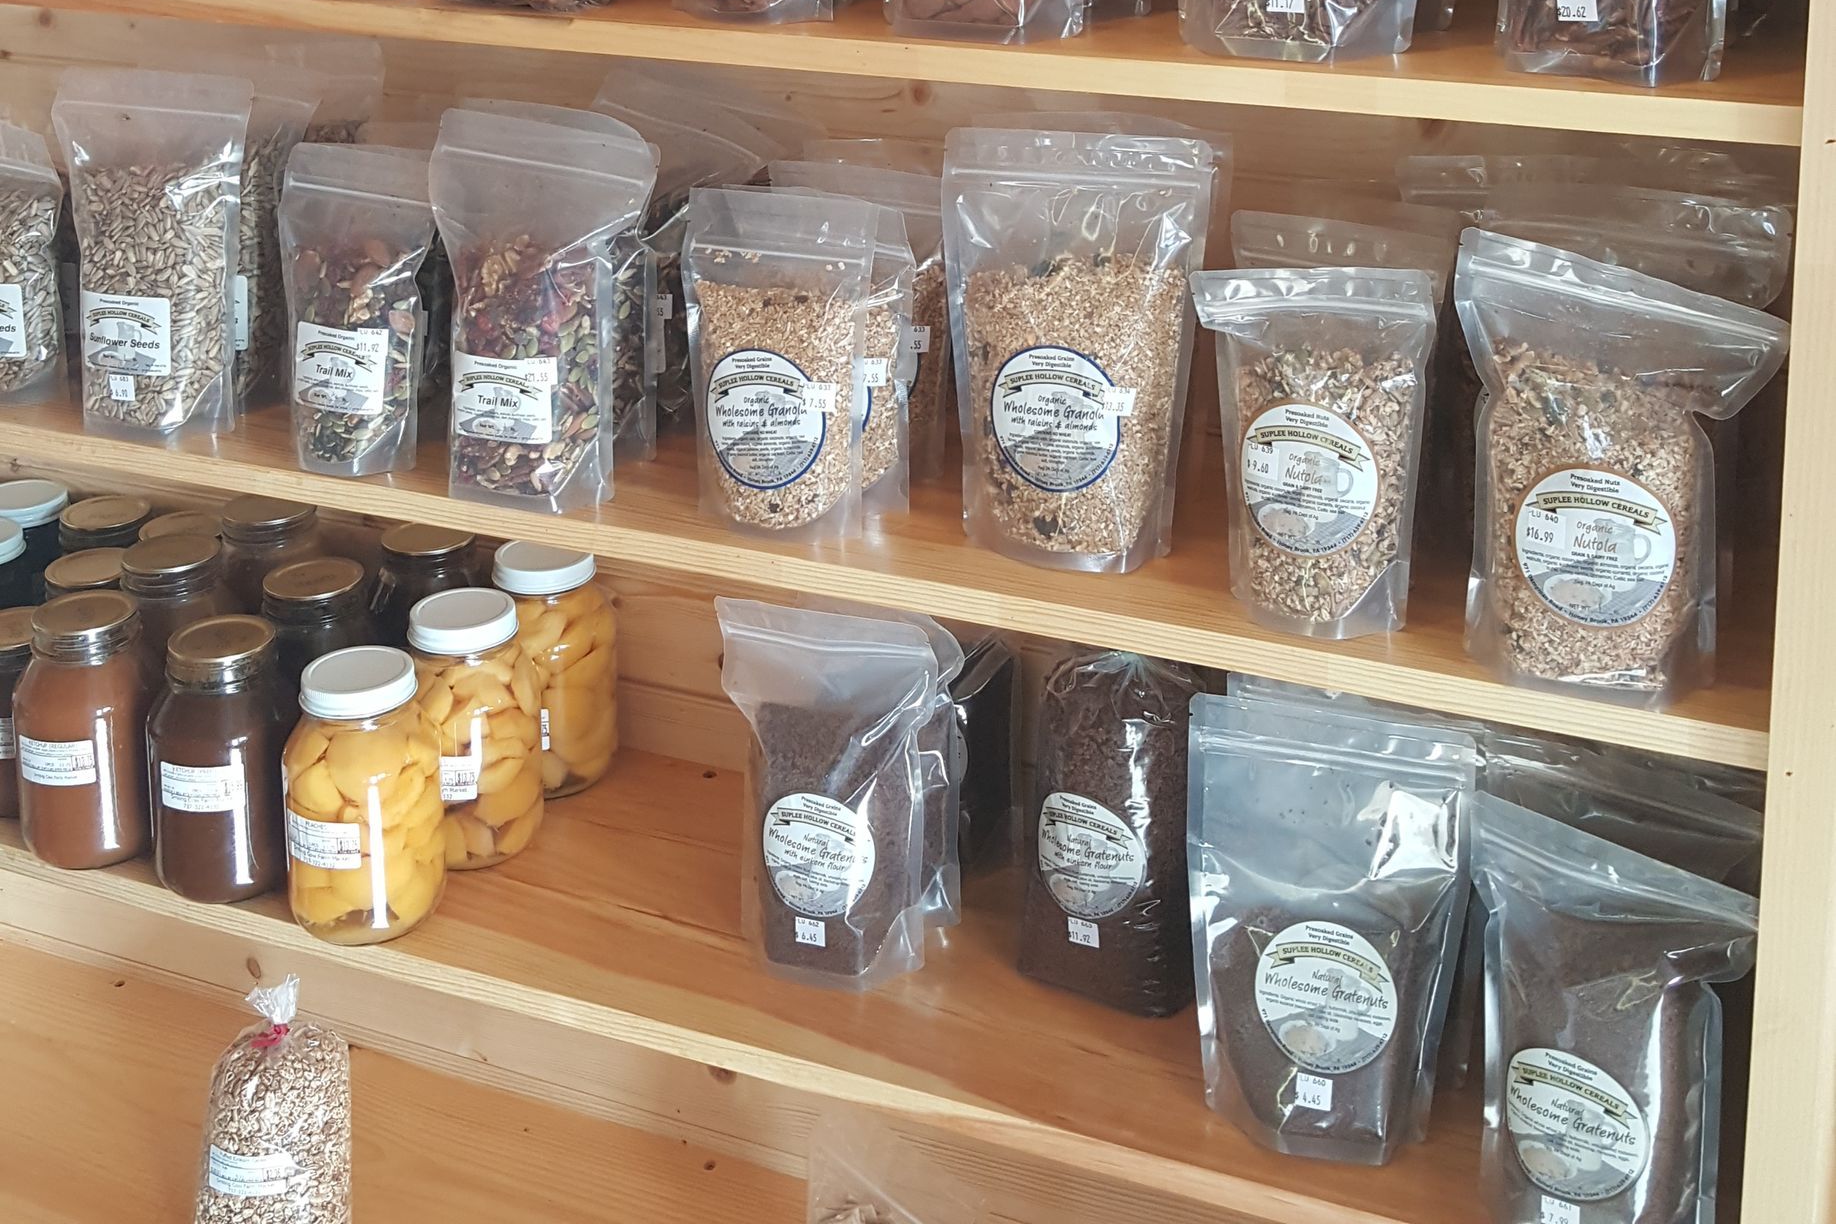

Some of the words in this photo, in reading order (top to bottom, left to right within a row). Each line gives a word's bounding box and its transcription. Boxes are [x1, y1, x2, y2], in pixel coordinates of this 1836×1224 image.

[1557, 5, 1586, 19] $20.62
[89, 332, 128, 347] Sunflower
[130, 339, 160, 349] Seeds
[316, 364, 332, 376] Trail
[335, 368, 352, 378] Mix
[718, 377, 738, 388] SUPLEE
[738, 374, 765, 383] HOLLOW
[765, 375, 794, 387] CEREALS
[1010, 374, 1034, 384] SUPLEE
[1065, 376, 1095, 390] CEREALS
[478, 395, 498, 406] Trail
[500, 398, 518, 408] Mix
[1003, 401, 1060, 417] Wholesome
[715, 404, 764, 418] Wholesome
[722, 418, 735, 427] with
[736, 419, 760, 428] raisins
[761, 419, 767, 428] &
[770, 417, 801, 427] almonds
[1011, 416, 1027, 424] with
[1028, 418, 1052, 428] raisins
[1065, 421, 1098, 431] almonds
[1286, 416, 1298, 424] Very
[1260, 430, 1286, 438] SUPLEE
[1288, 430, 1318, 440] HOLLOW
[1320, 436, 1353, 454] CEREALS
[1262, 446, 1273, 455] 639
[1284, 467, 1322, 486] Nutola
[1570, 473, 1603, 485] Presoaked
[1571, 482, 1585, 491] Very
[1586, 484, 1619, 494] Digestible
[1543, 496, 1572, 505] SUPLEE
[1574, 496, 1610, 507] HOLLOW
[1611, 502, 1650, 519] CEREALS
[1545, 513, 1559, 524] 640
[1526, 527, 1554, 543] $16.99
[1573, 534, 1618, 553] Nutola
[781, 811, 802, 820] SUPLEE
[803, 814, 830, 827] HOLLOW
[1064, 814, 1088, 825] HOLLOW
[1089, 820, 1117, 835] CEREALS
[769, 827, 816, 855] Wholesome
[803, 834, 830, 848] Natural
[1042, 829, 1081, 856] Wholesome
[1084, 847, 1134, 862] Gratenuts
[784, 849, 798, 860] with
[827, 859, 846, 872] flour
[1094, 860, 1113, 870] flour
[1305, 925, 1334, 936] Presoaked
[1335, 930, 1354, 939] Grains
[1308, 932, 1322, 941] Very
[1323, 935, 1350, 946] Digestible
[1282, 946, 1309, 954] SUPLEE
[1311, 946, 1341, 958] HOLLOW
[1312, 970, 1342, 985] Natural
[1264, 972, 1328, 997] Wholesome
[1332, 985, 1389, 1009] Gratenuts
[1522, 1067, 1549, 1080] SUPLEE
[1550, 1074, 1583, 1092] HOLLOW
[1584, 1087, 1620, 1110] CEREALS
[1302, 1092, 1321, 1106] 4.45
[1551, 1098, 1584, 1116] Natural
[1510, 1086, 1569, 1125] Wholesome
[1572, 1116, 1636, 1146] Gratenuts
